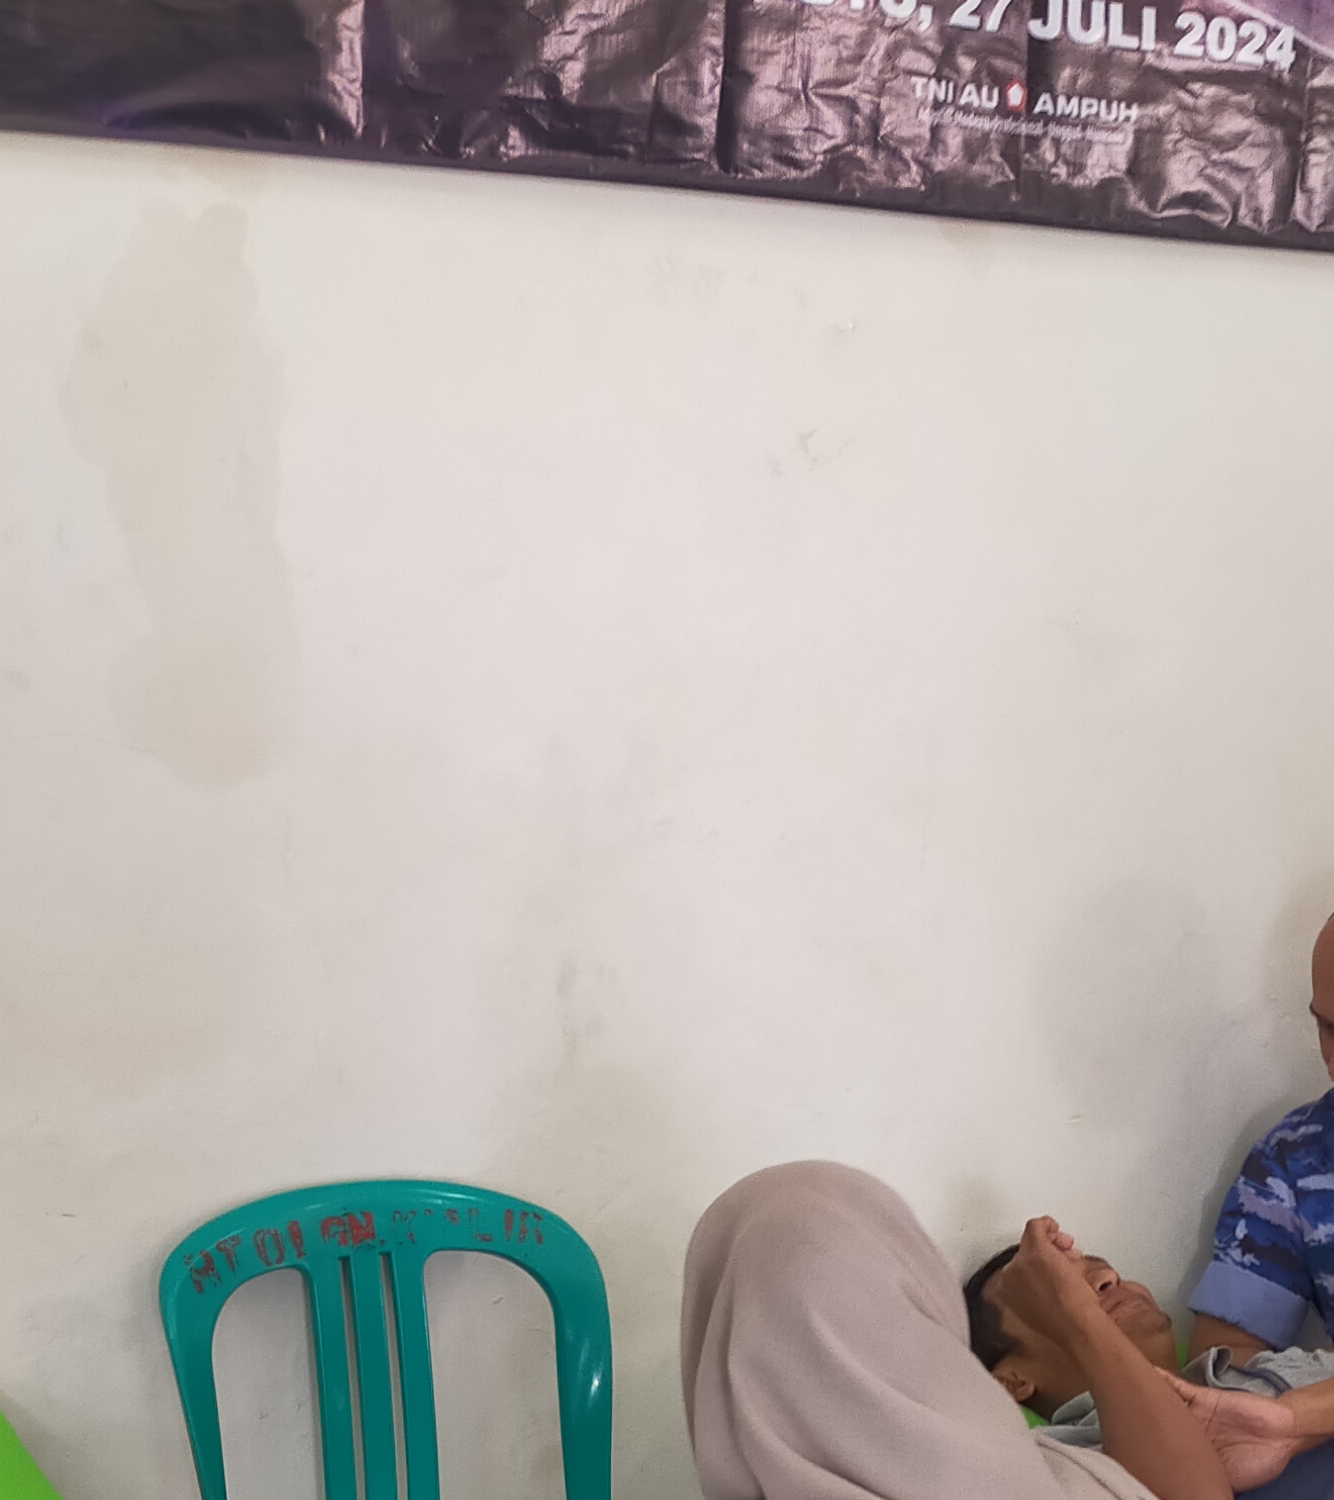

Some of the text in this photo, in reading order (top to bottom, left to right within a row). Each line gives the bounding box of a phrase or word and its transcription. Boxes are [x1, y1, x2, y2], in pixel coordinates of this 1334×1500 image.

[1028, 0, 1156, 52] JULI
[1174, 12, 1297, 71] 2024
[910, 76, 1139, 124] TNI AU AMPUH
